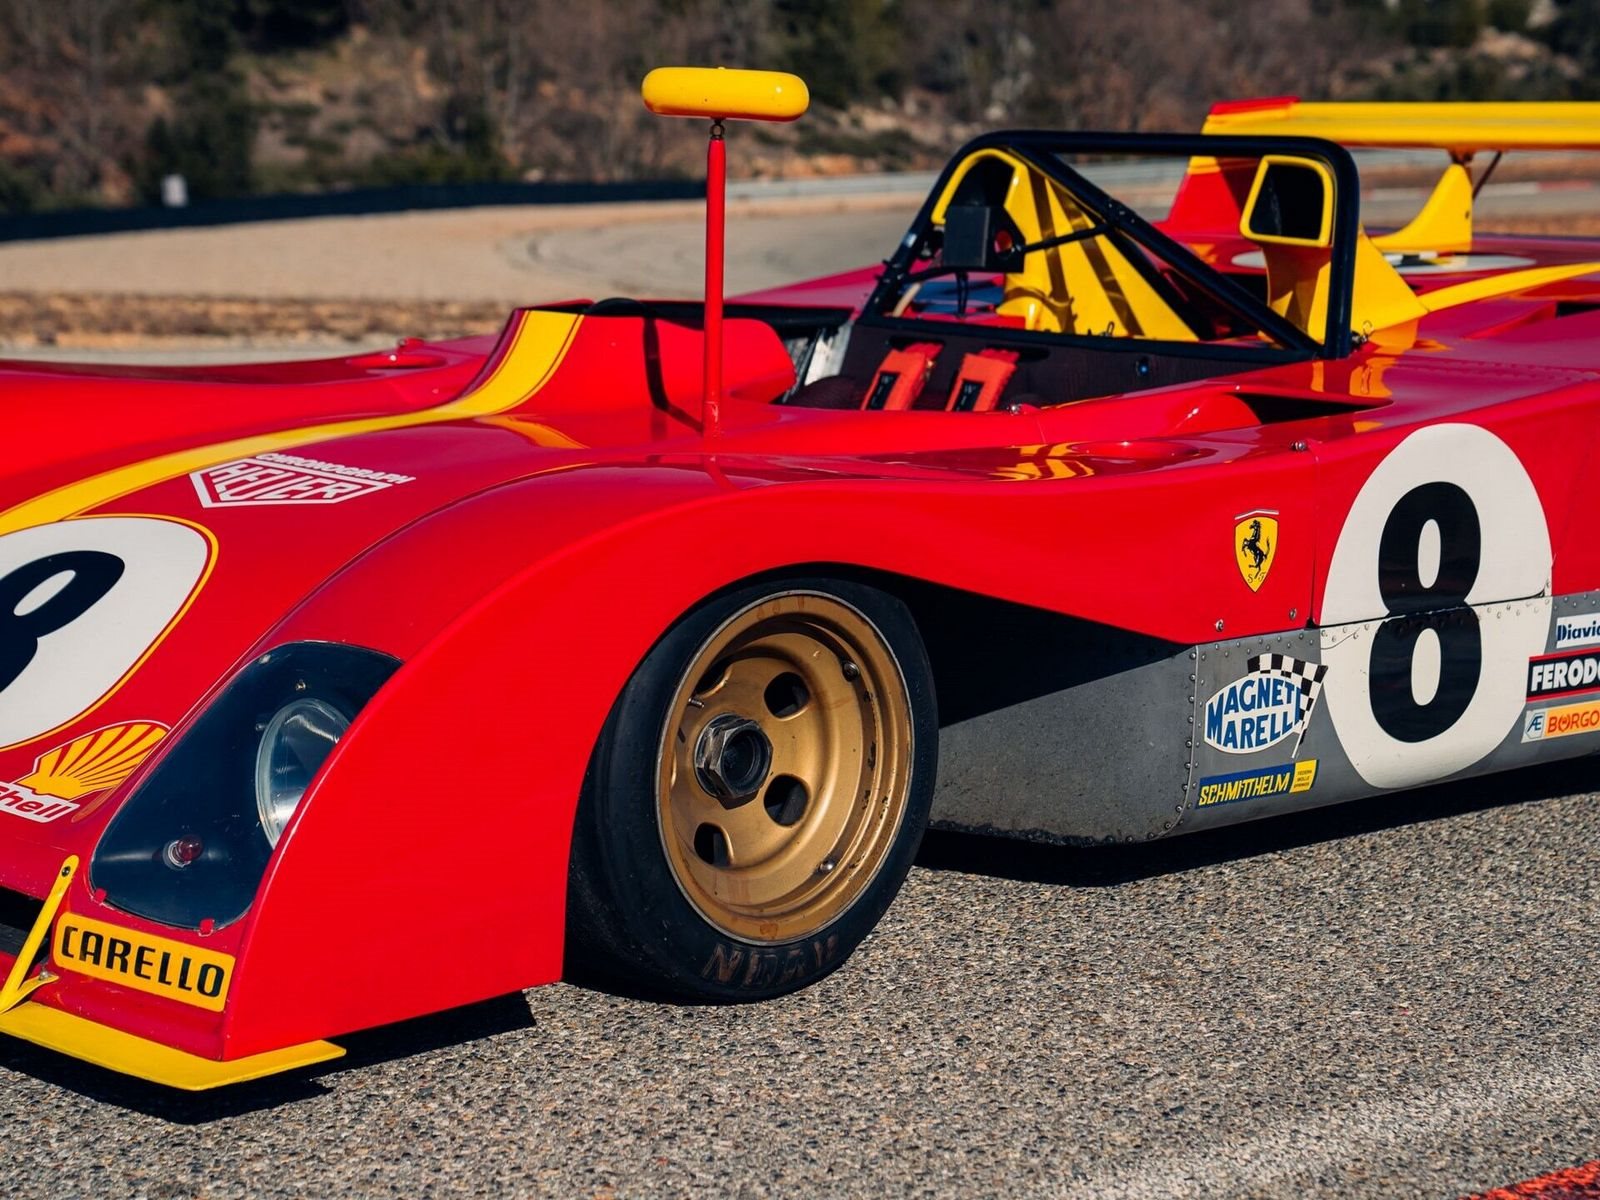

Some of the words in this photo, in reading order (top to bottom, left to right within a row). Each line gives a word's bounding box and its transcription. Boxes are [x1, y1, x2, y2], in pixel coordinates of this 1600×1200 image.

[209, 463, 362, 501] HEUER
[255, 453, 416, 484] CHRONOGRAPH
[1369, 481, 1482, 743] 8
[1530, 657, 1600, 692] FEROD
[1207, 678, 1301, 723] MAGNETI
[1206, 701, 1301, 749] MARELLI
[1547, 709, 1600, 733] BORGO
[1198, 772, 1291, 806] SCHMITTHELM
[61, 925, 225, 998] CARELLO
